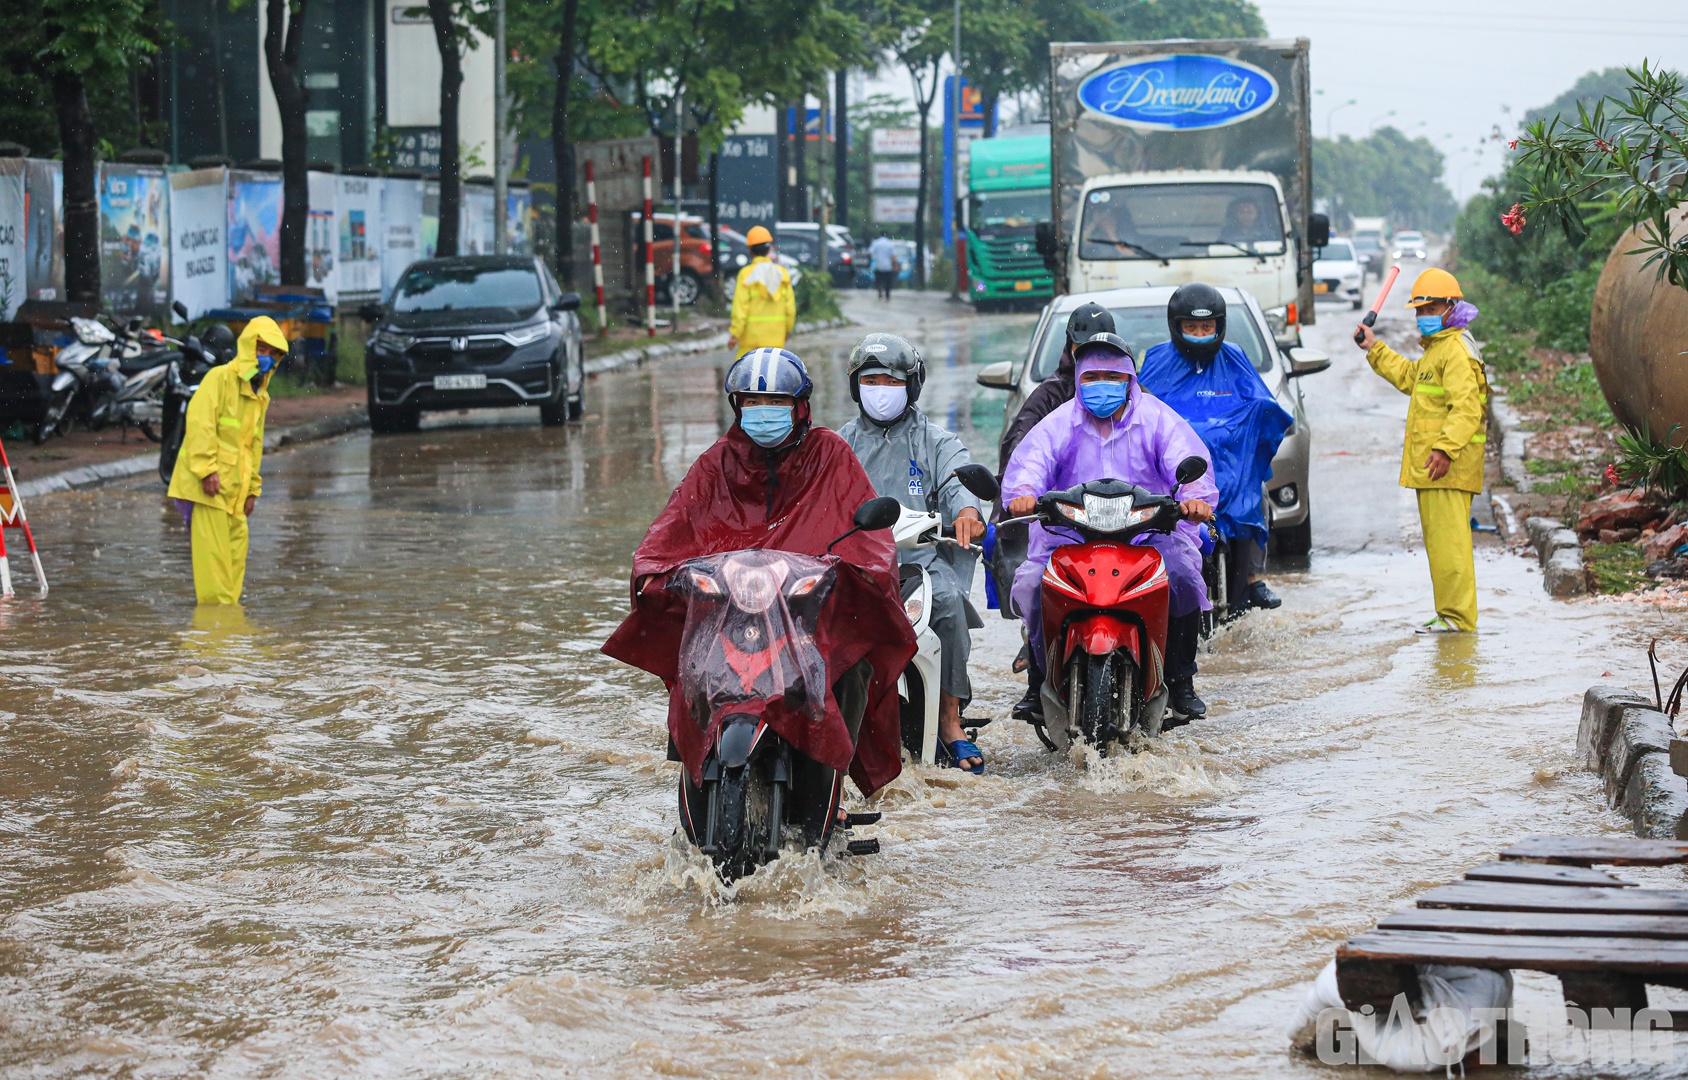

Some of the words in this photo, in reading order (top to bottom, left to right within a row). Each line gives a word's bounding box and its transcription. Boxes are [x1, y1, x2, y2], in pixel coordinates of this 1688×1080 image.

[1101, 68, 1257, 116] Dreamland
[723, 140, 742, 157] Xe
[746, 137, 768, 157] Tải
[717, 202, 737, 218] Xe
[740, 200, 774, 221] Buýt
